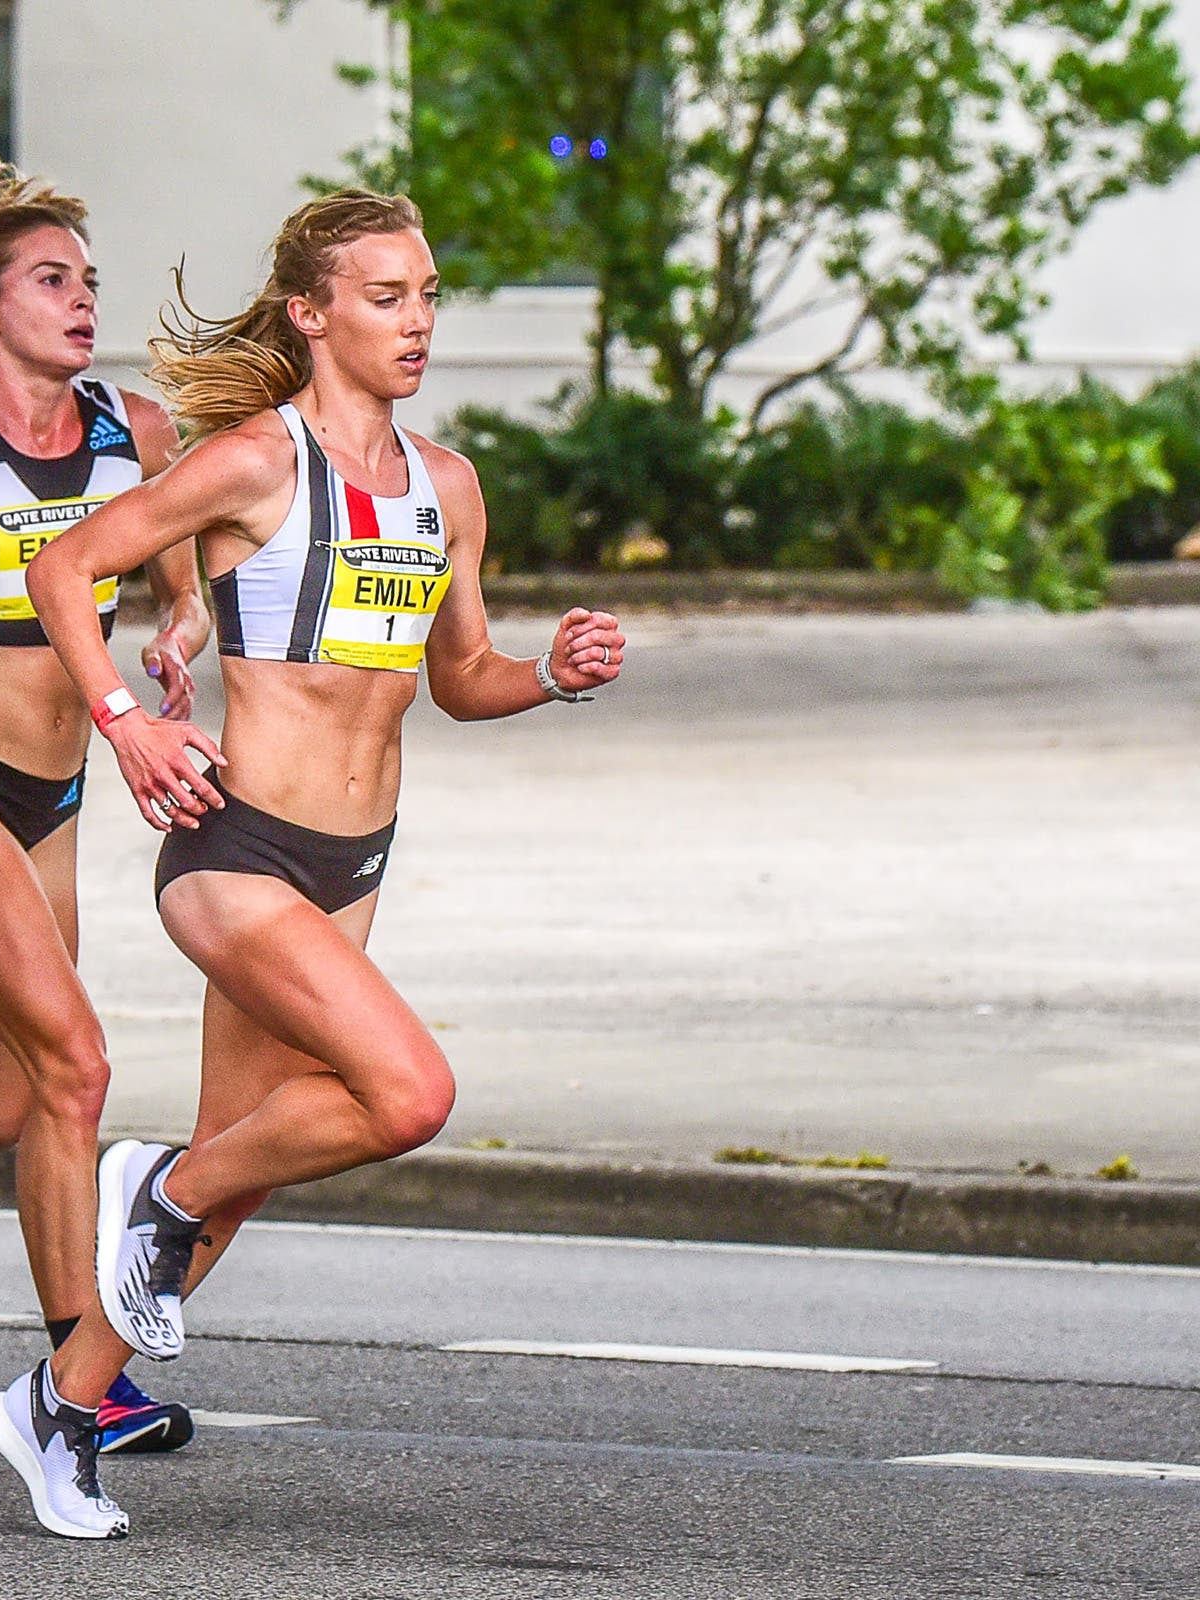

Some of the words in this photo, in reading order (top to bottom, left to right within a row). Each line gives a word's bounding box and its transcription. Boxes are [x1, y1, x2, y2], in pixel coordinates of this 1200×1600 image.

[2, 510, 40, 526] GATE
[41, 505, 86, 522] RIVER
[345, 547, 381, 560] GATE
[381, 548, 419, 564] RIVER
[420, 551, 445, 565] RUN
[354, 576, 437, 609] EMILY
[385, 614, 396, 641] 1
